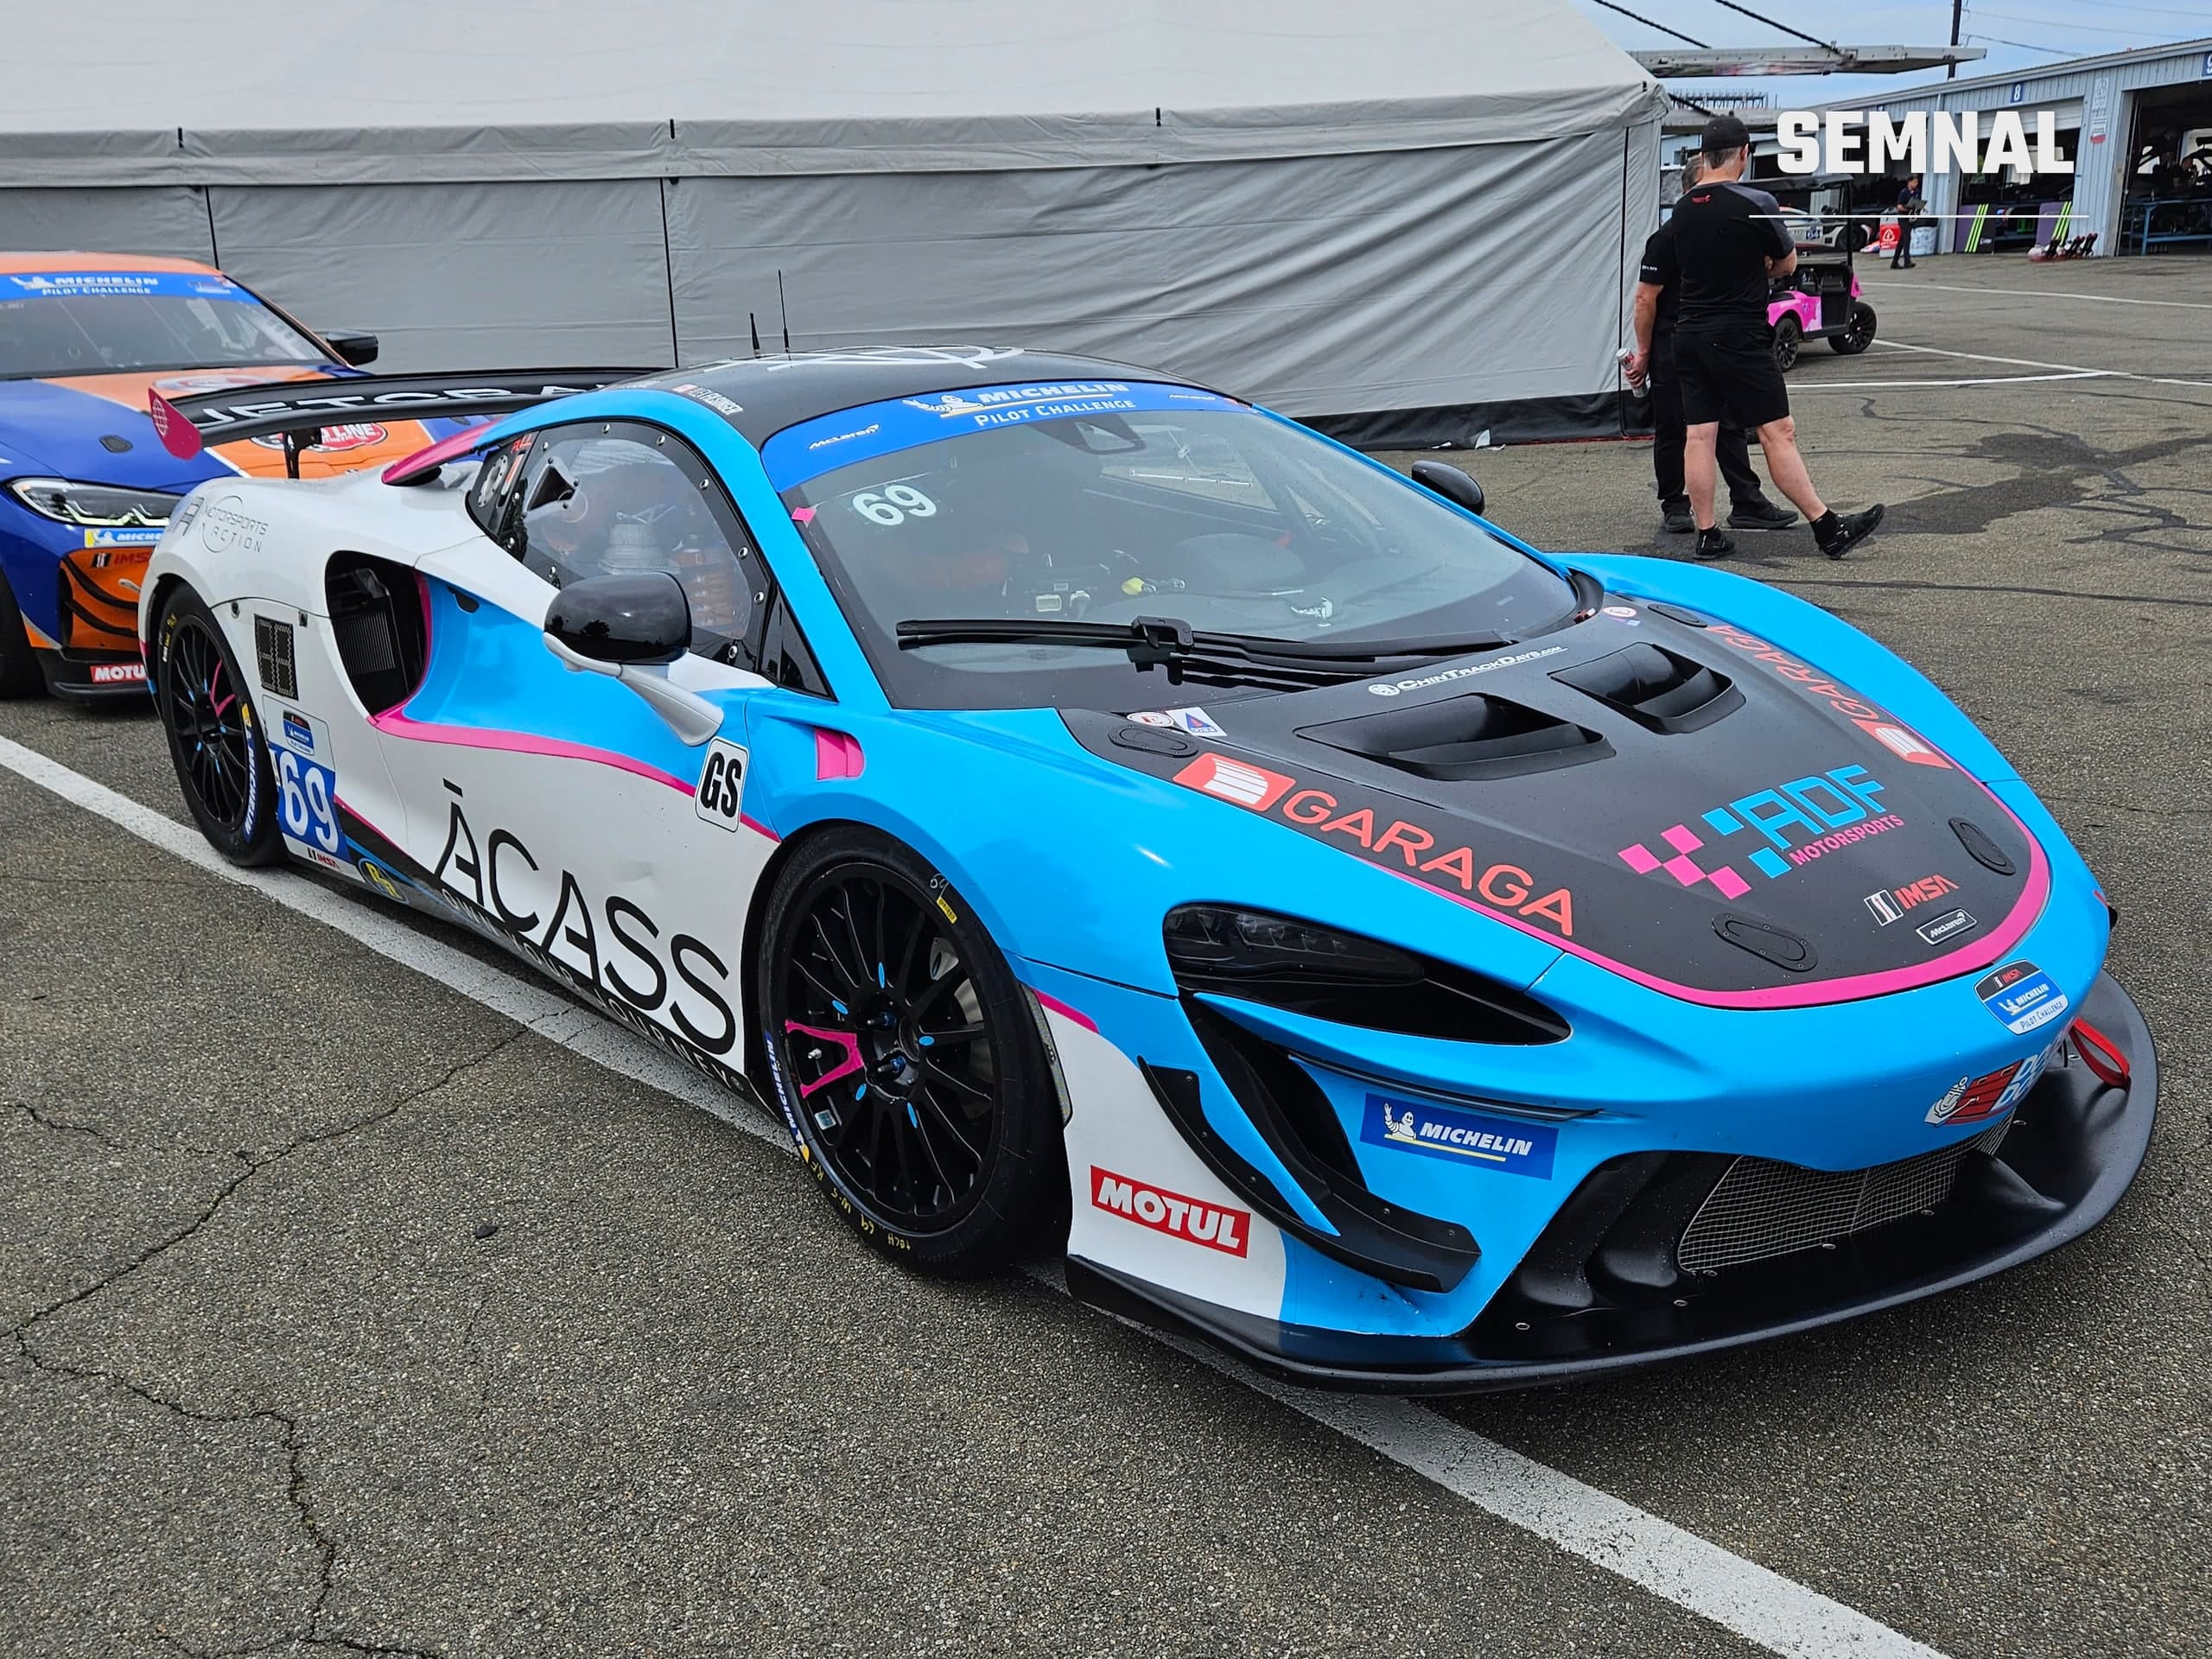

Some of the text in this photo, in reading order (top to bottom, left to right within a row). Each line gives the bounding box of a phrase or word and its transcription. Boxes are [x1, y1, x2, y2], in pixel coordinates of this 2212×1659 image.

[2013, 84, 2021, 101] 8
[55, 276, 158, 286] MICHELIN
[974, 399, 1137, 427] PILOT CHALLENGE
[977, 384, 1129, 404] MICHELIN
[852, 484, 937, 526] 69
[1706, 625, 1879, 720] GARAGA
[280, 750, 339, 853] 69
[700, 752, 743, 819] GS
[1729, 764, 1887, 851] ADF
[1789, 814, 1904, 865] MOTORSPORTS
[1282, 790, 1573, 937] GARAGA
[1894, 874, 1960, 910] IMSA
[1929, 912, 1967, 938] McLaren
[503, 929, 582, 990] YOUR
[2015, 983, 2050, 1006] MICHELIN
[766, 1039, 797, 1128] MICHELIN
[1419, 1121, 1532, 1156] MICHELIN
[1097, 1174, 1242, 1249] MOTUL
